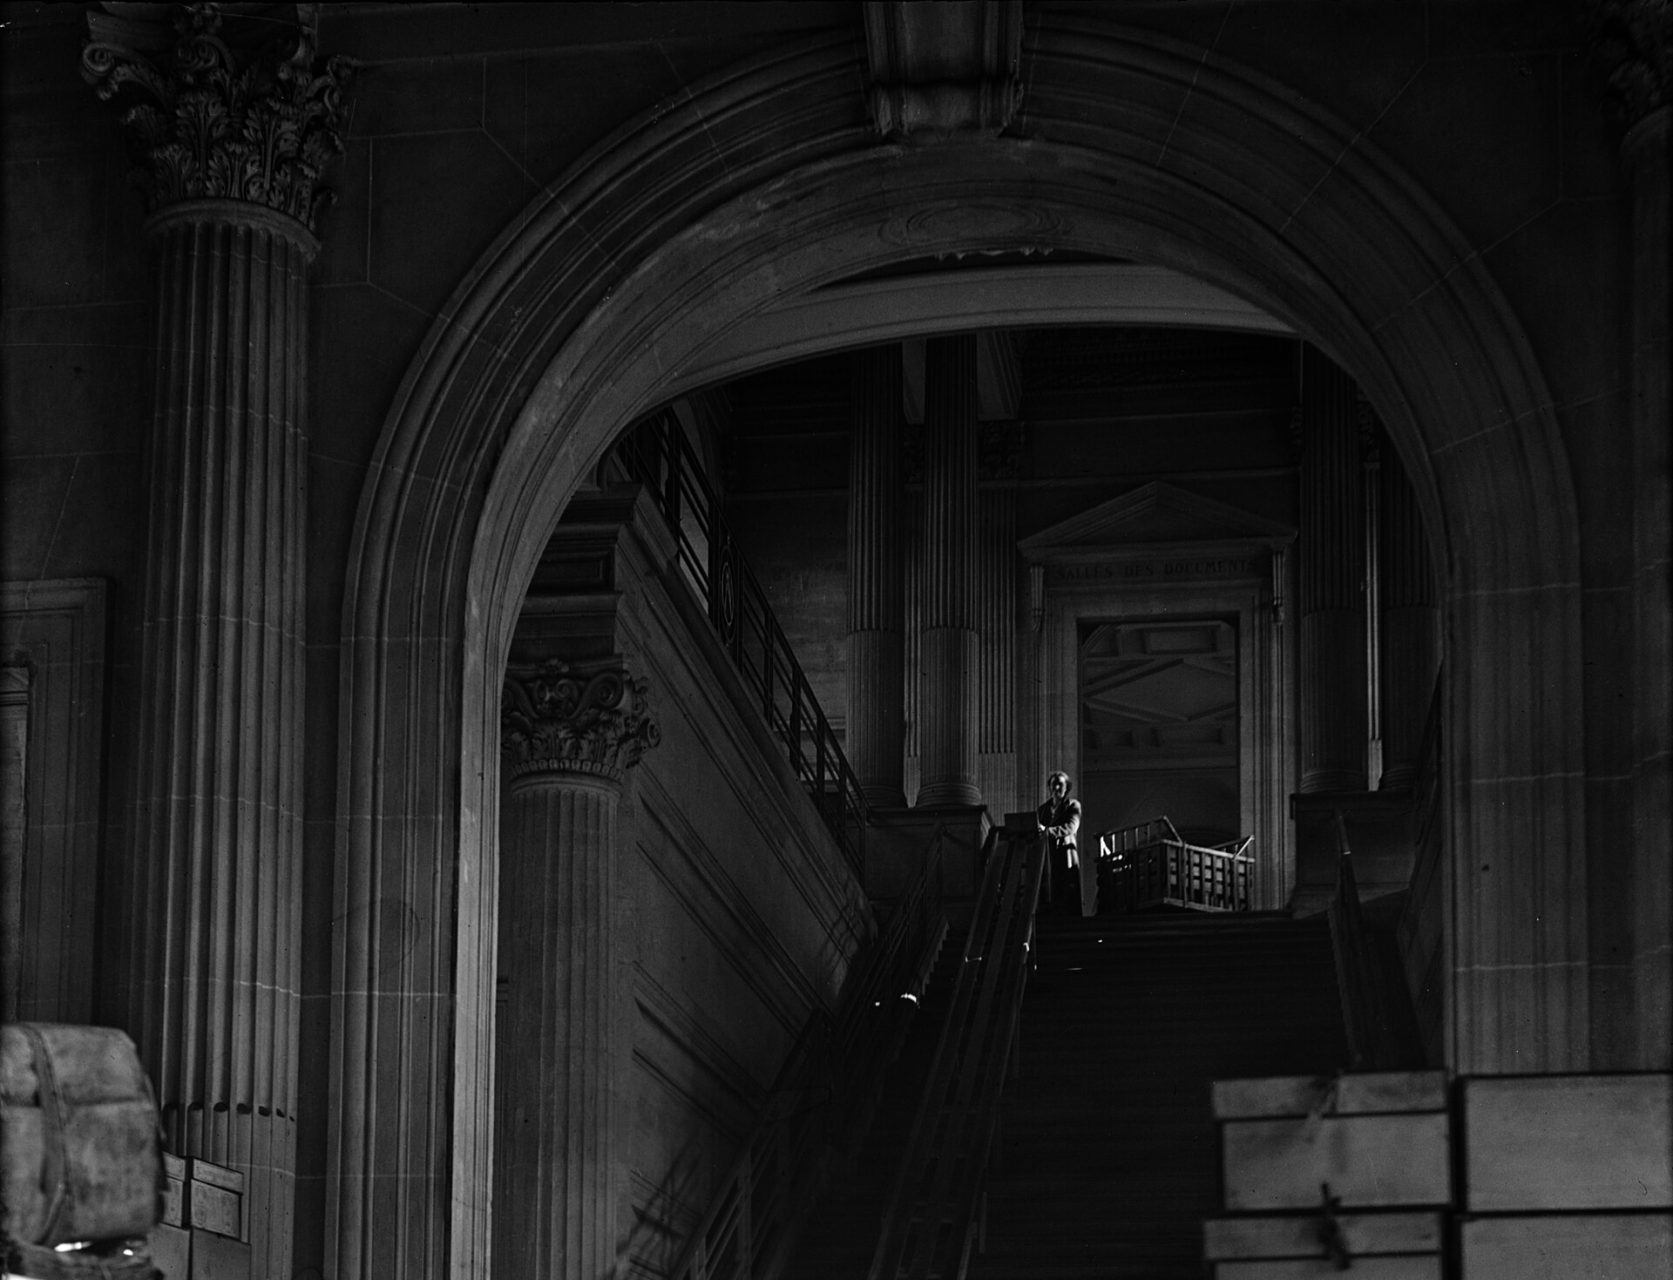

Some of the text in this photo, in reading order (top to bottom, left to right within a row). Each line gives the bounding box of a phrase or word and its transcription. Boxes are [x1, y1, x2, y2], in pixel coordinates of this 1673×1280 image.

[1058, 559, 1257, 581] SALLES DES DOCUMENTS
